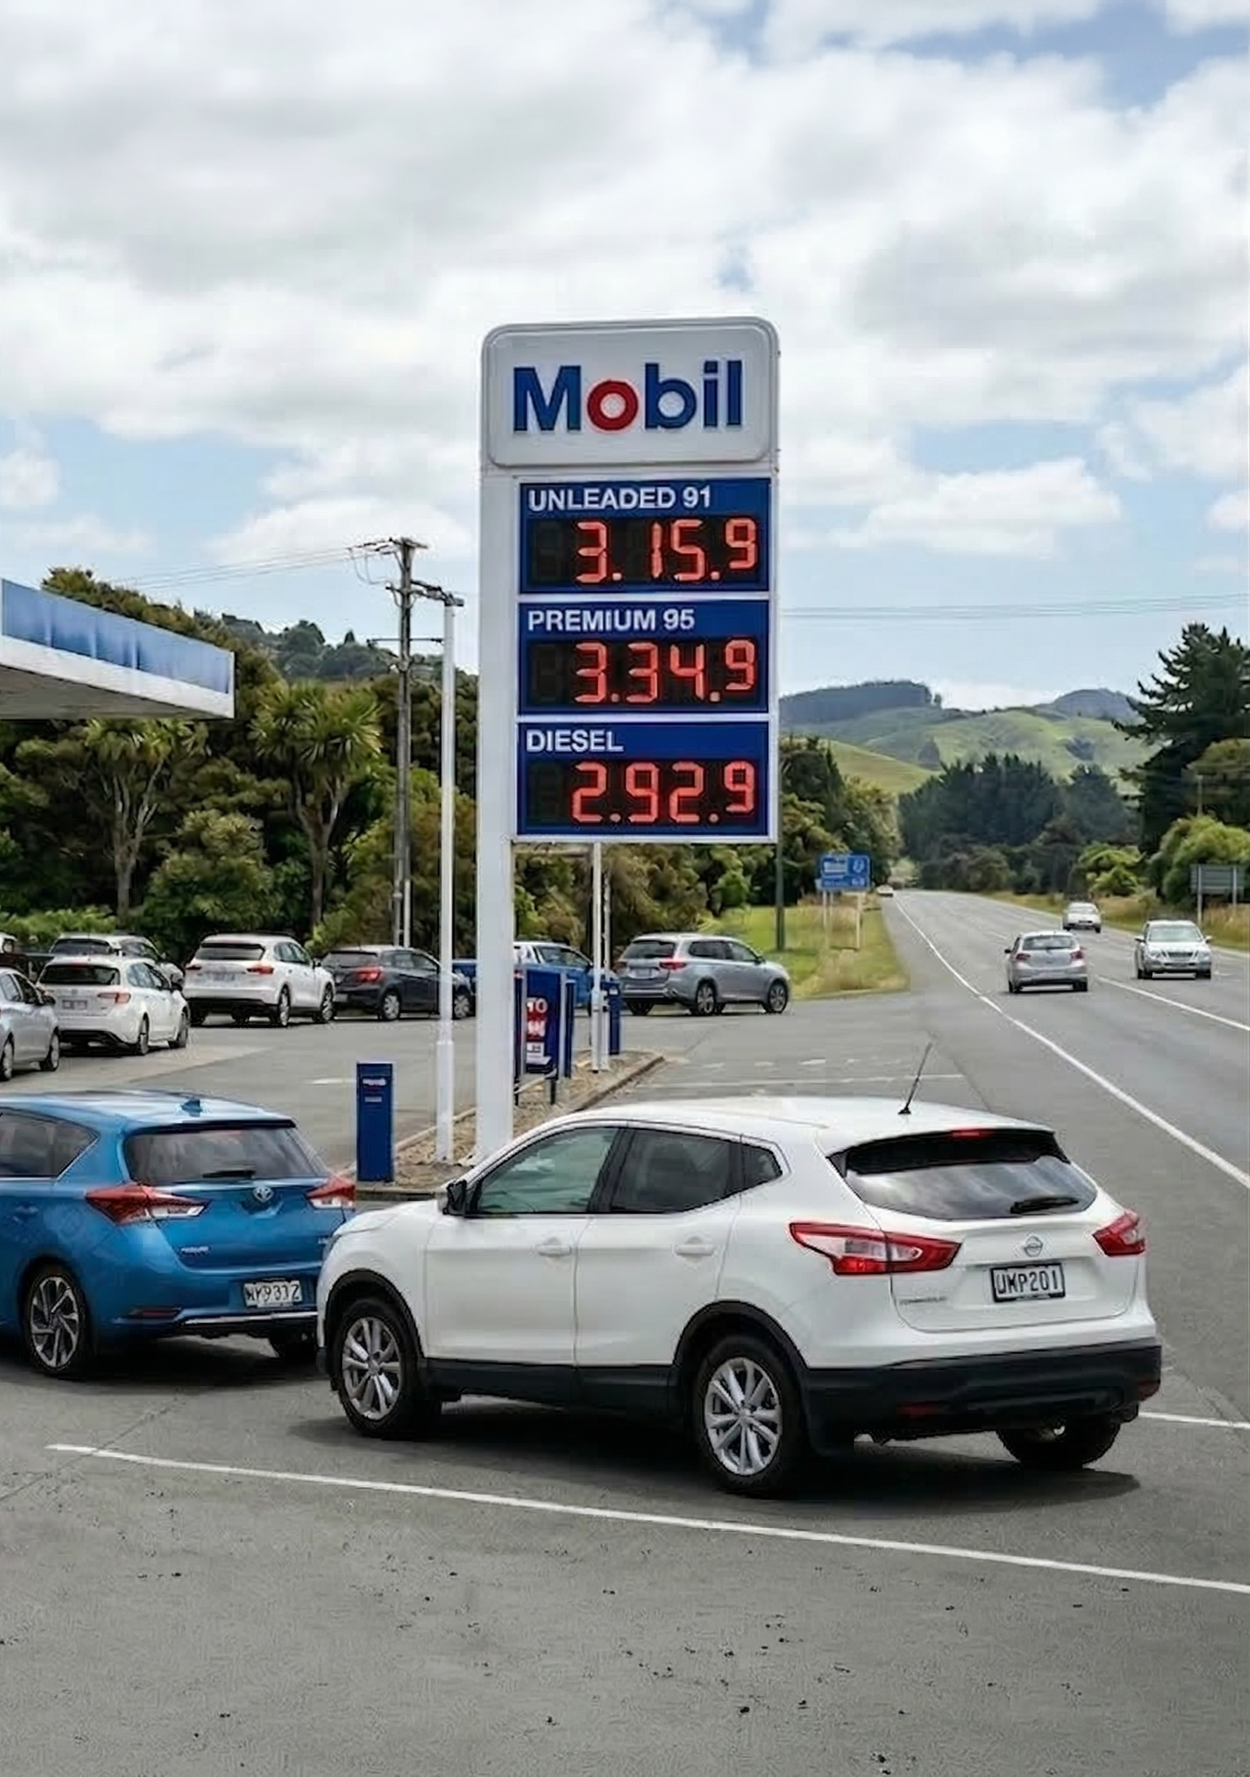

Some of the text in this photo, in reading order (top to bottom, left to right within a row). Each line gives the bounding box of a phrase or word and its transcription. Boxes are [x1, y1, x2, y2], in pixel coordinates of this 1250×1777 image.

[513, 360, 743, 431] Mobil
[528, 485, 711, 511] UNLEADED 91
[528, 609, 694, 632] PREMIUM 95
[574, 639, 756, 703] 3.34.9
[526, 729, 623, 752] DIESEL
[572, 761, 756, 823] 2.92.9
